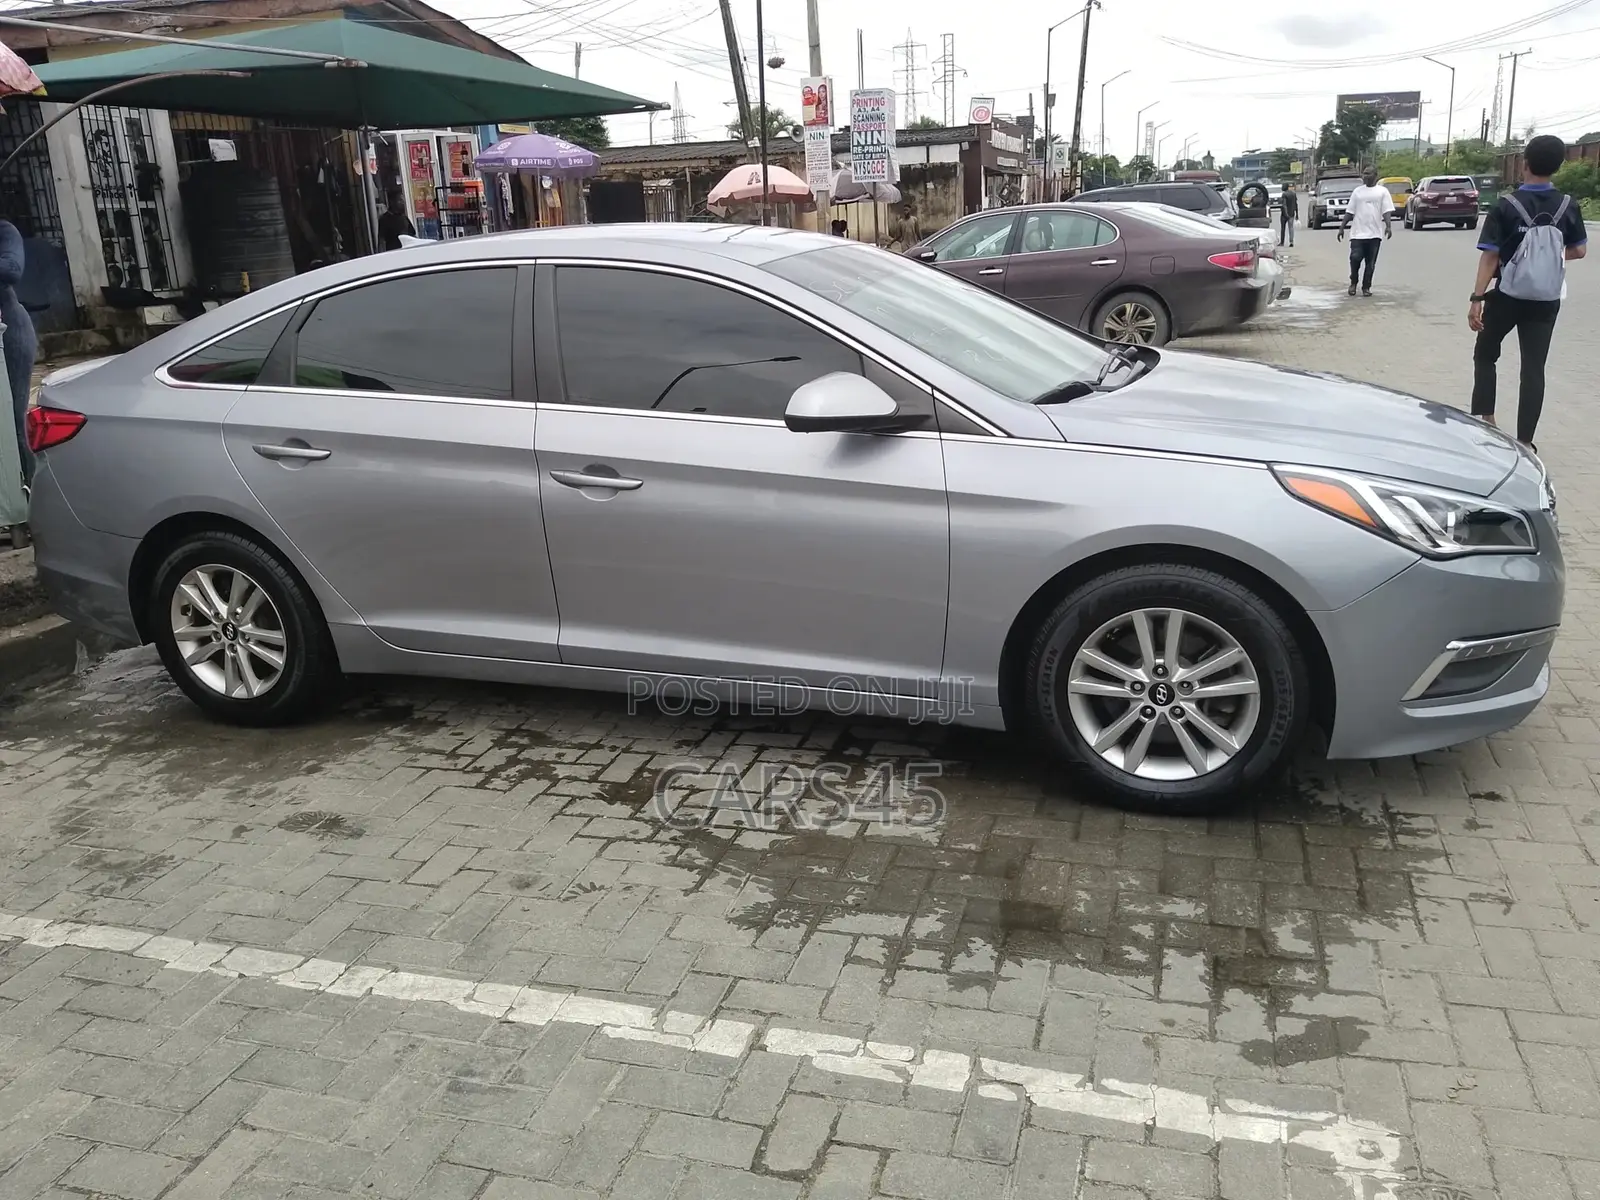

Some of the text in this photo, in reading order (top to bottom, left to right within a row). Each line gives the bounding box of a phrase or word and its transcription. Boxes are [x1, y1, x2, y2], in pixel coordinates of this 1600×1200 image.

[852, 97, 885, 108] PRINTING
[853, 113, 885, 123] SCANNING
[853, 122, 886, 130] PASSPORT
[810, 131, 825, 140] NIN
[853, 131, 885, 145] NIN
[853, 145, 886, 153] RE-PRINT
[520, 158, 552, 166] AIRTIME
